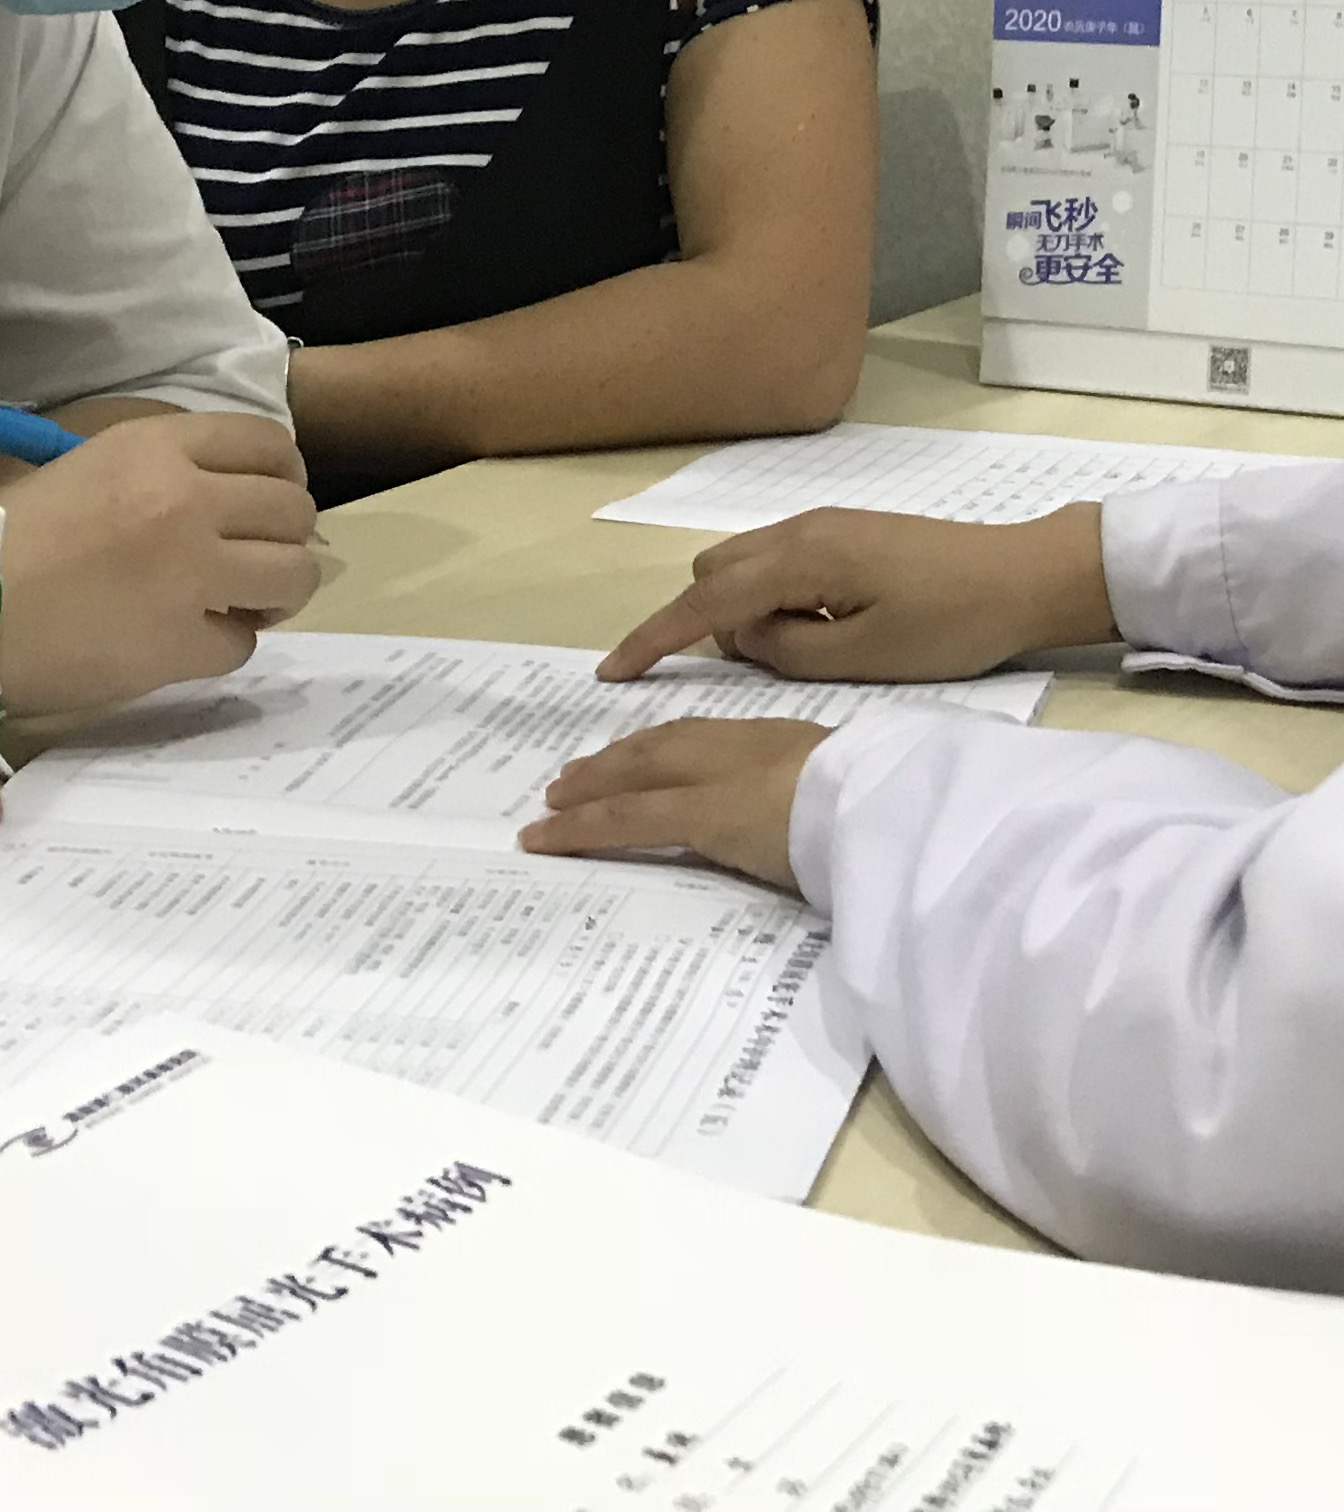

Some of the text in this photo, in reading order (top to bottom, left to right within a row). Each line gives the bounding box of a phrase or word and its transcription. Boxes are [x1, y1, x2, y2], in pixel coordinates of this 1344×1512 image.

[1004, 8, 1062, 32] 2020
[1036, 231, 1105, 252] 无刀手术
[1032, 253, 1125, 285] 更安全
